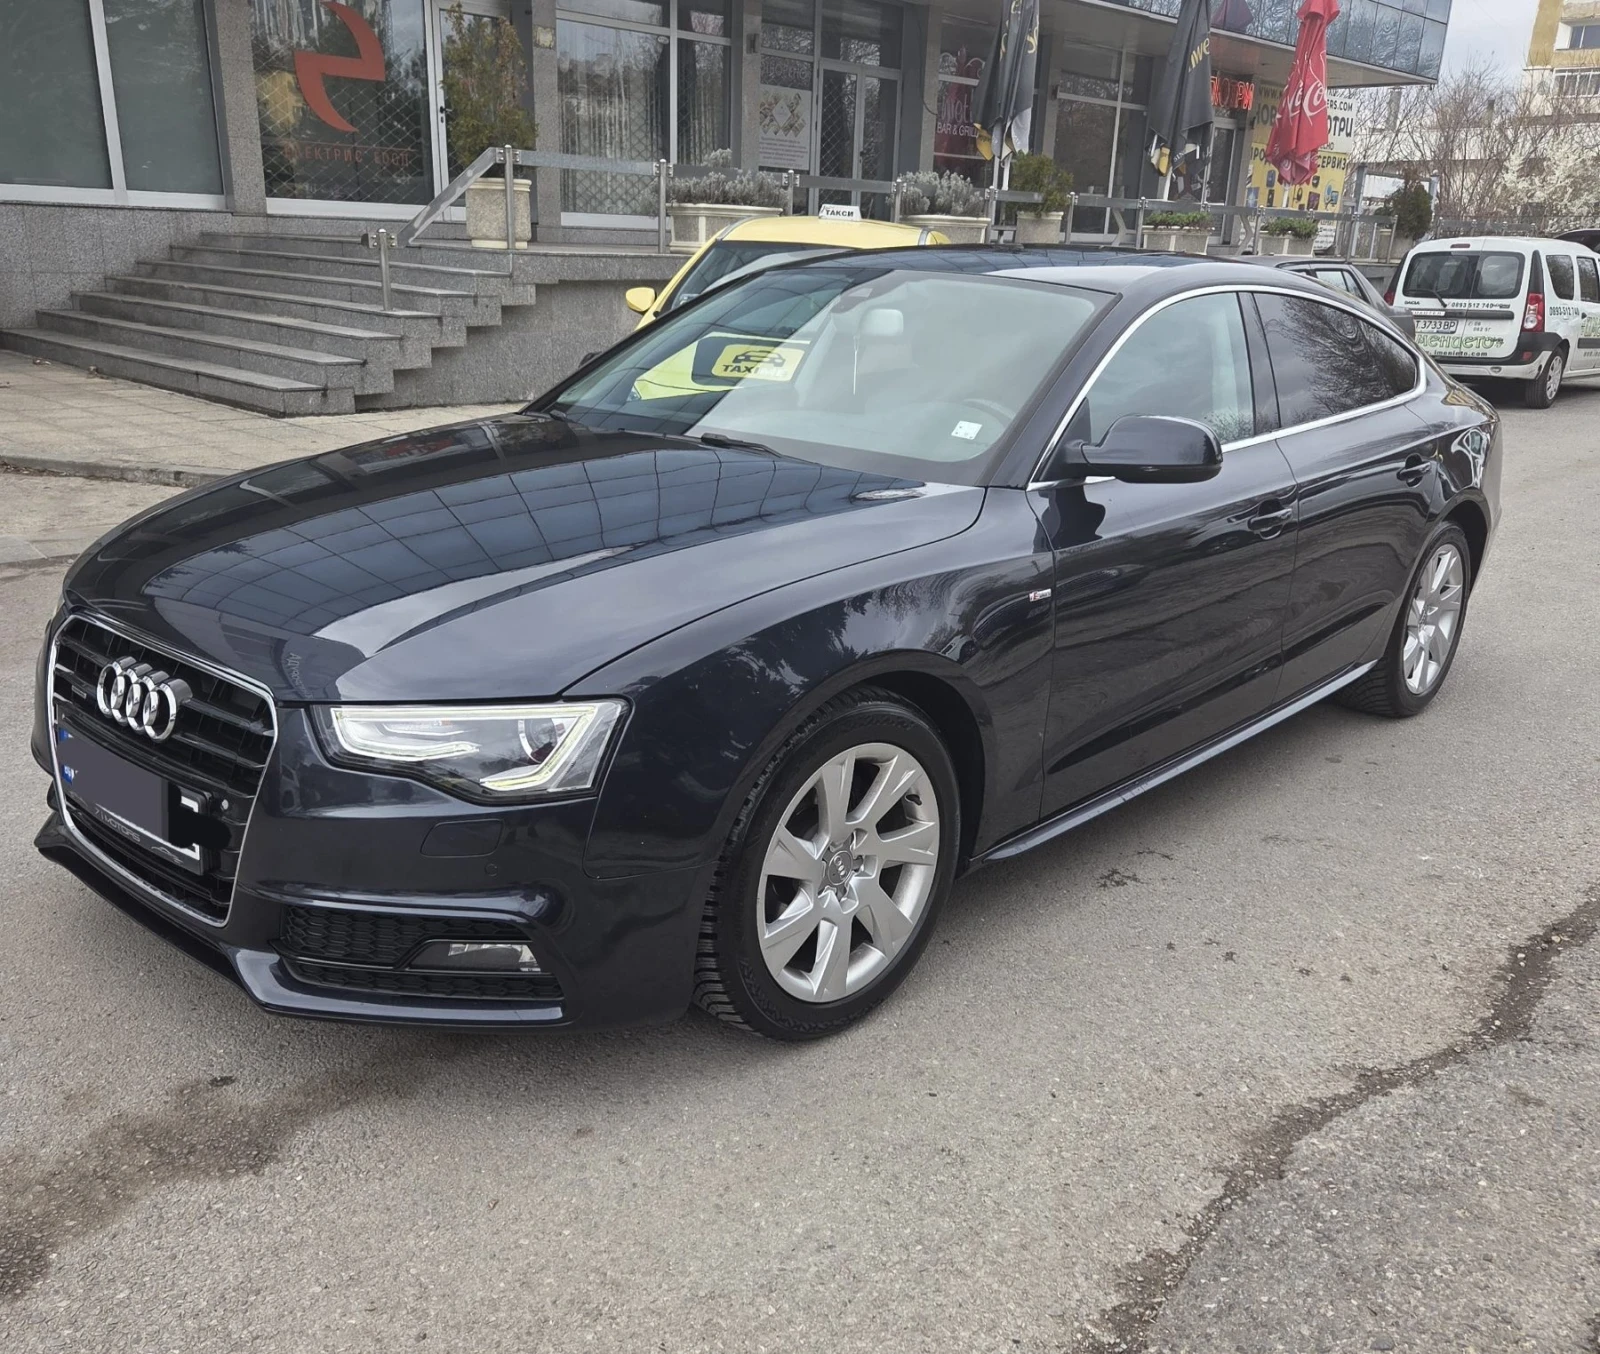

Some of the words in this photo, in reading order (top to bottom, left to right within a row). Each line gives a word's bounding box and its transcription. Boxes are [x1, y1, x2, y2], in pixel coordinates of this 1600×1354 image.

[937, 122, 952, 135] BAR
[826, 209, 854, 218] ТАКСИ
[1422, 320, 1442, 331] 3733
